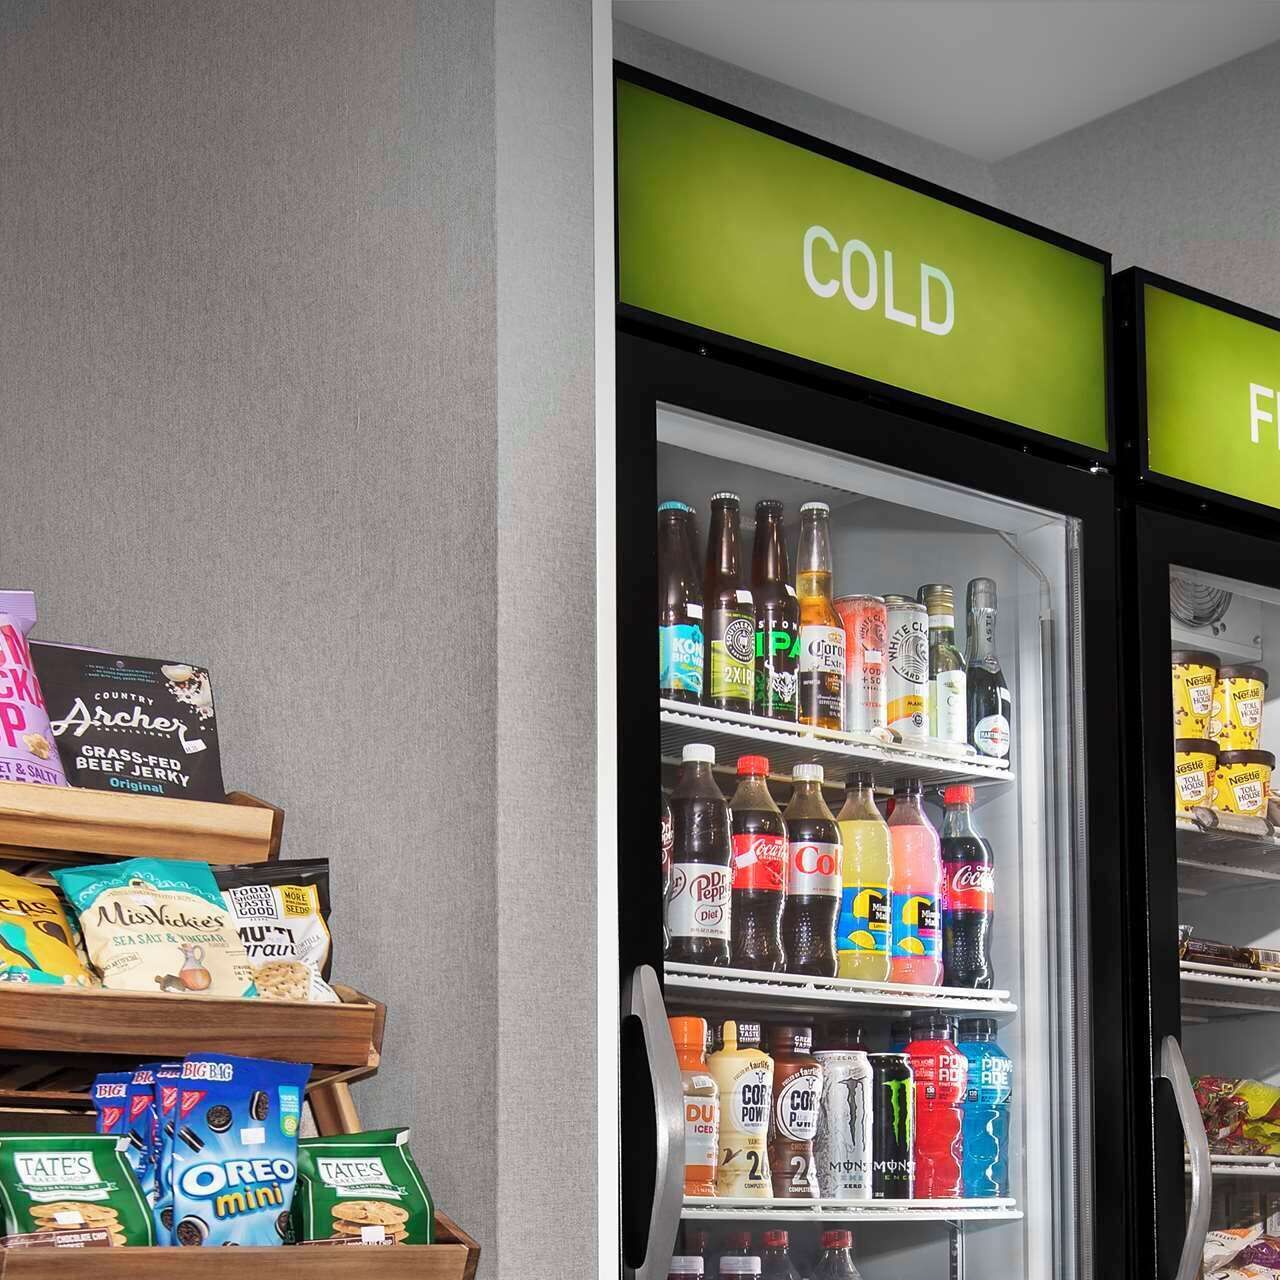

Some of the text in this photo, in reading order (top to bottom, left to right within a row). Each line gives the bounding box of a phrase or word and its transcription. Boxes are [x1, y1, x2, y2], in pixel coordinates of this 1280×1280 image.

[803, 225, 955, 336] COLD
[888, 623, 911, 662] WHITE
[94, 691, 154, 706] COUNTRY
[1195, 688, 1209, 696] TOLL
[1243, 702, 1258, 710] TOLL
[50, 697, 187, 751] Archer
[81, 744, 182, 771] GRASS-FED
[28, 765, 58, 785] SALTY
[76, 756, 190, 788] BEEF JERKY
[1183, 775, 1201, 784] TOLL
[110, 777, 164, 794] Original
[1240, 785, 1258, 794] TOLL
[232, 886, 269, 898] FOOD
[284, 892, 307, 902] MORE
[238, 900, 273, 909] TASTE
[239, 906, 275, 917] GOOD
[96, 901, 224, 932] Miss Vickie's
[701, 909, 719, 922] Diet
[113, 935, 137, 946] SEA
[139, 934, 163, 945] SALT
[739, 1024, 760, 1032] GREAT
[182, 1062, 233, 1081] BIG BAG
[981, 1071, 1009, 1085] ADE
[694, 1126, 714, 1134] ICED
[20, 1157, 91, 1176] TATE'S
[321, 1162, 383, 1179] TATE'S
[181, 1159, 295, 1197] OREO
[216, 1182, 283, 1218] mini
